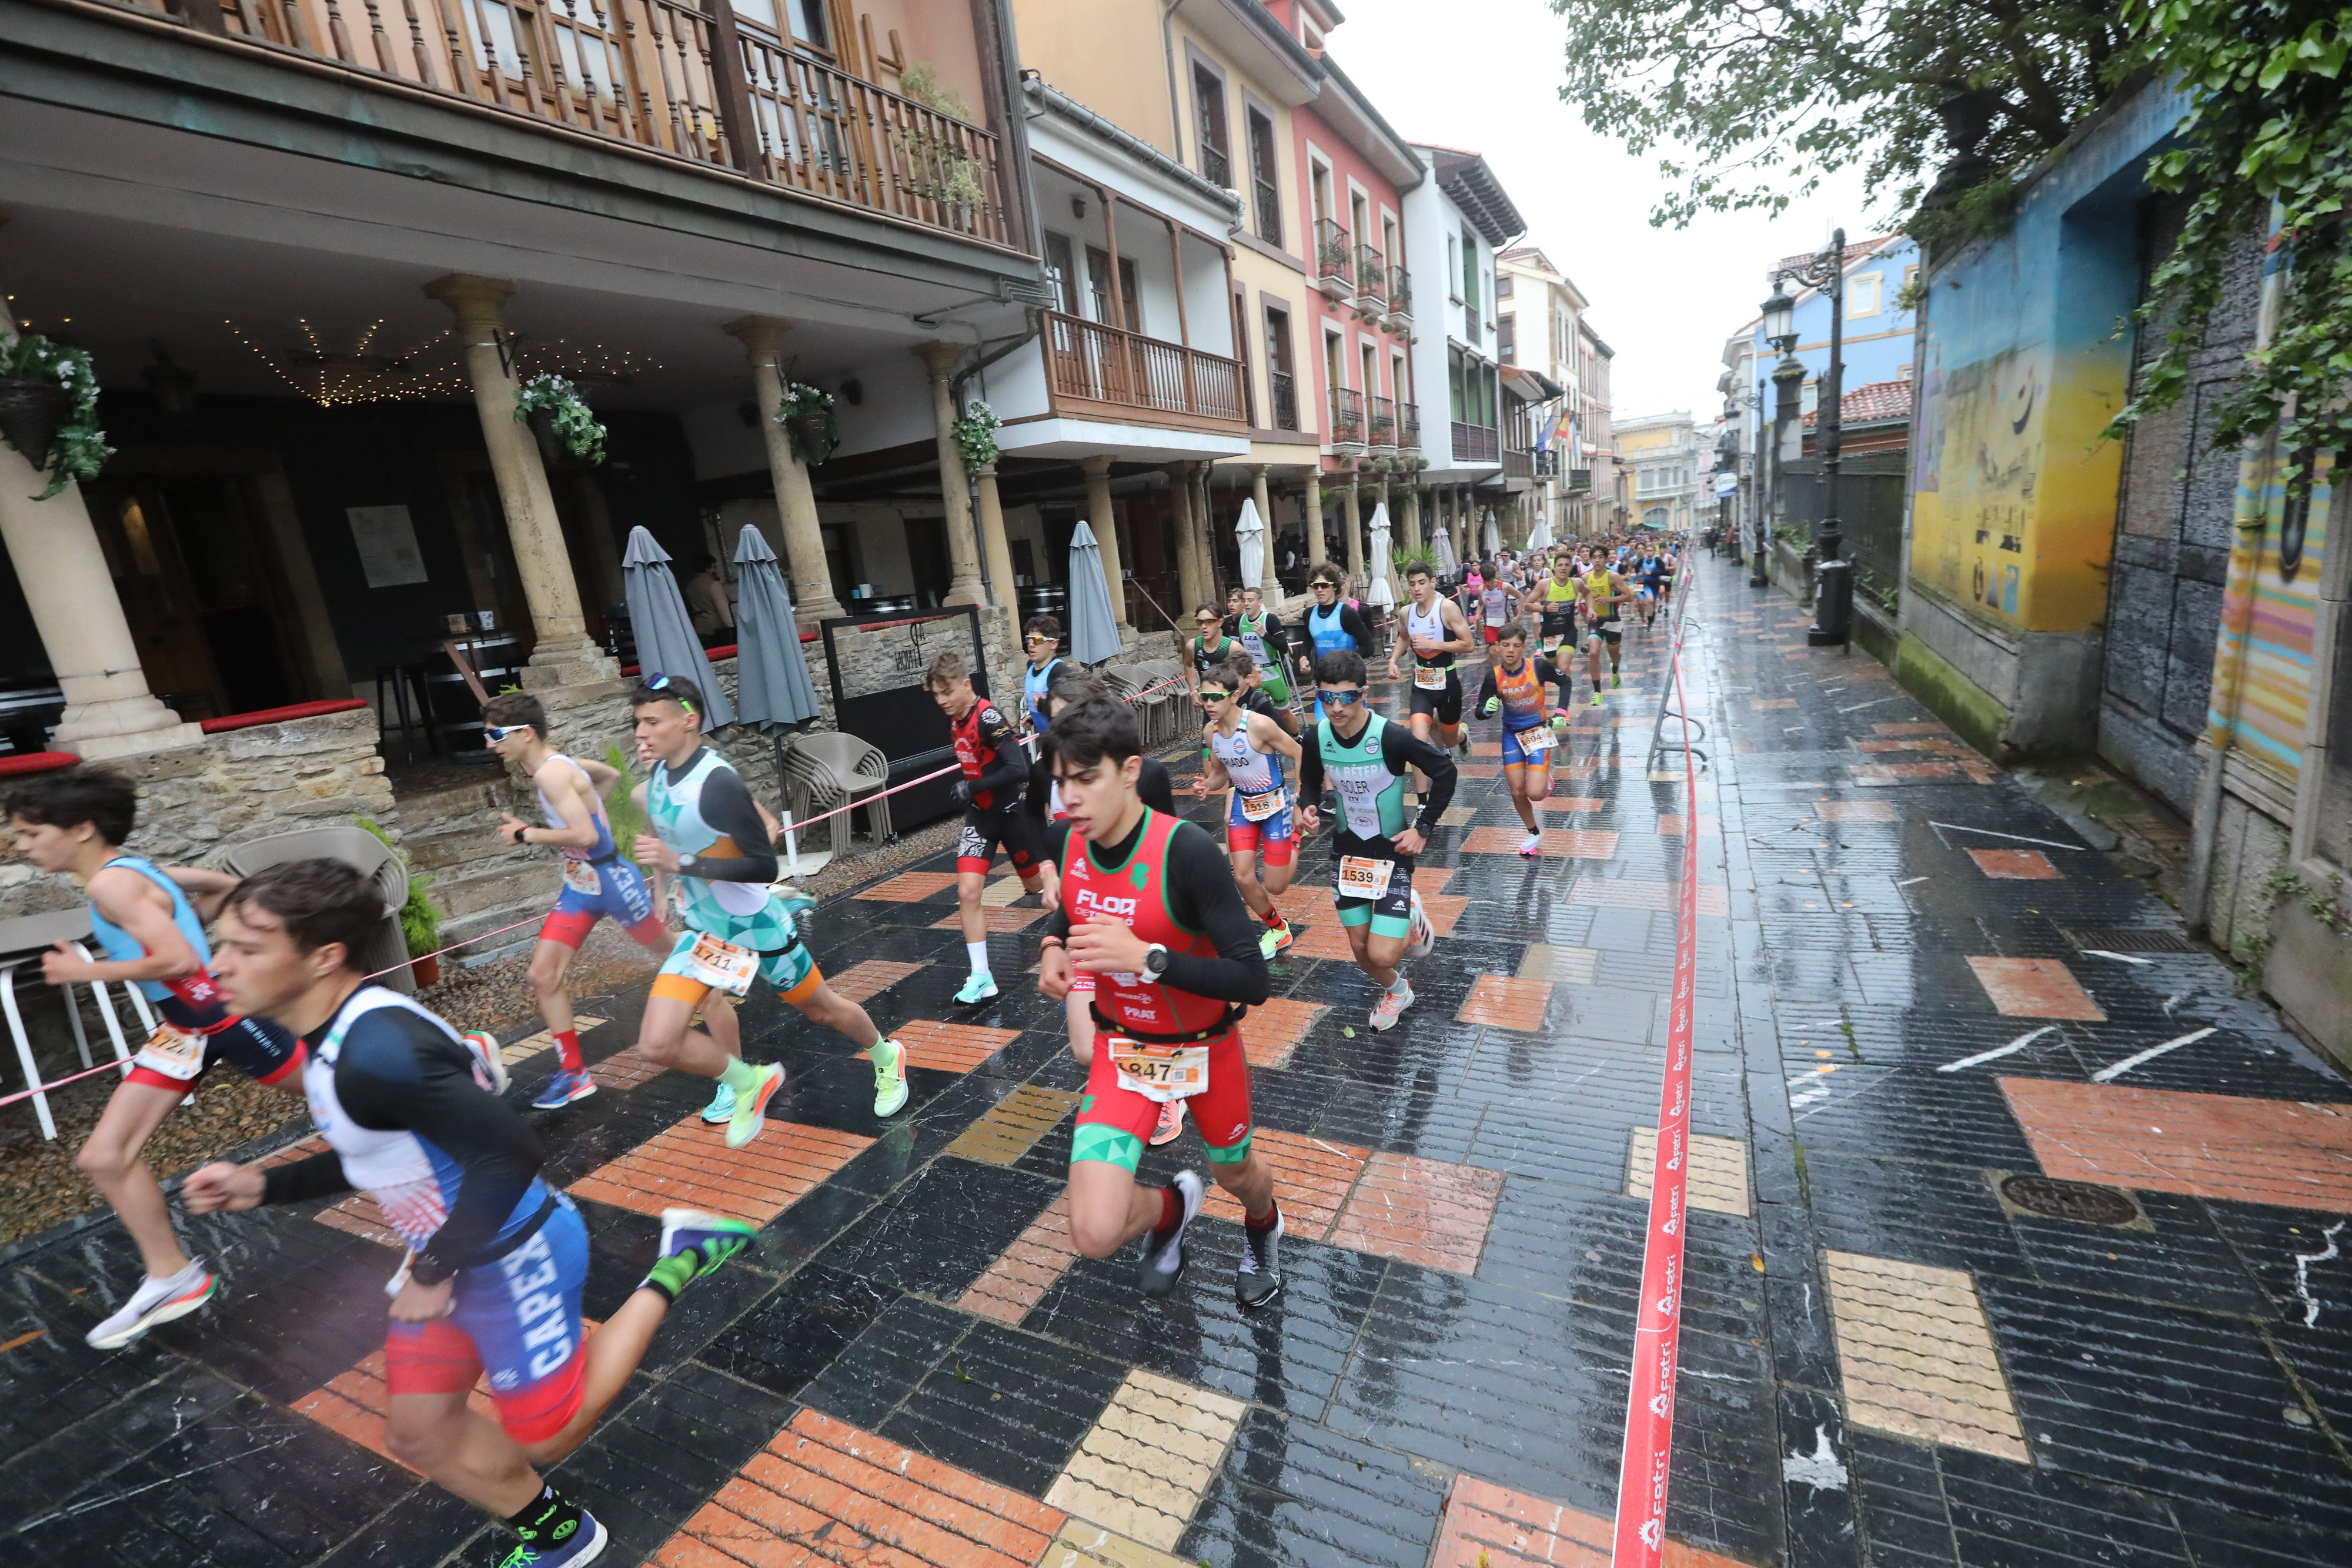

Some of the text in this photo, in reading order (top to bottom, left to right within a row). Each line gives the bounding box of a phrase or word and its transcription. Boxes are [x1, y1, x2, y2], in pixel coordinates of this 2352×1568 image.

[1502, 686, 1526, 694] PRAT
[1341, 780, 1370, 794] SOLER
[1244, 801, 1269, 813] 1518
[1341, 869, 1373, 883] 1539
[606, 865, 650, 922] CAPEX
[1076, 888, 1137, 915] FLOR
[1124, 1006, 1156, 1020] PRAT
[500, 1229, 574, 1381] CAPEX
